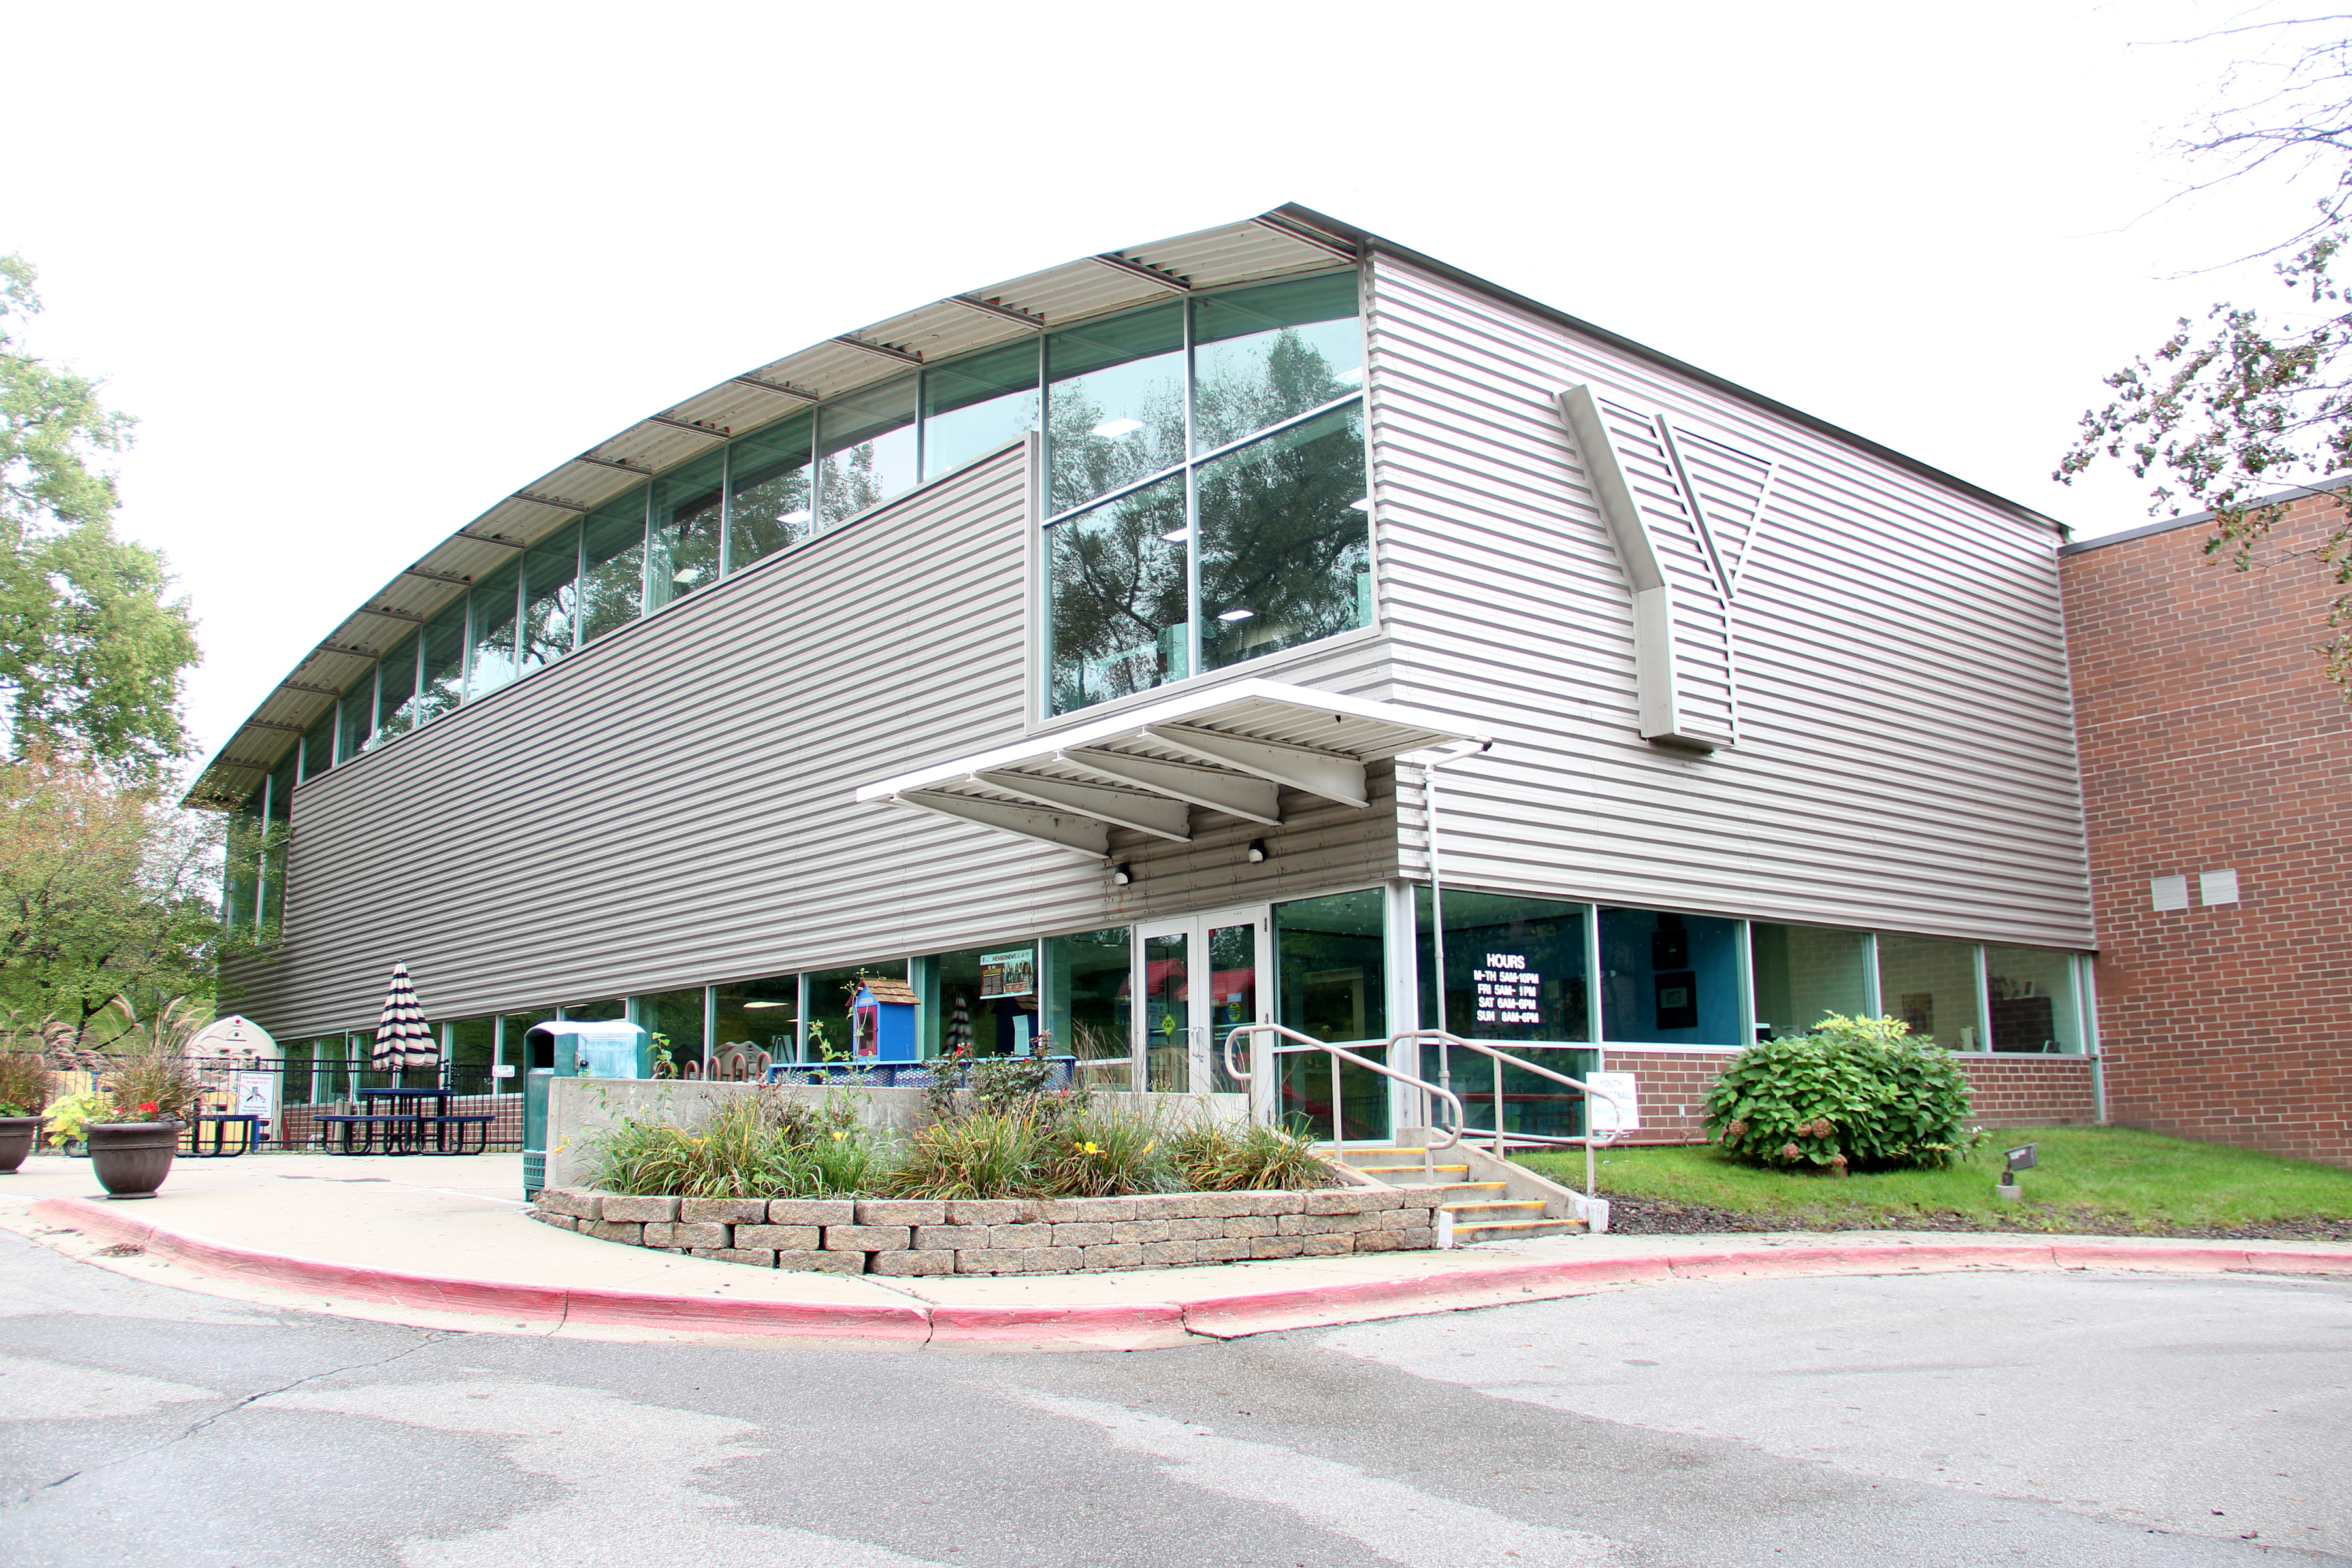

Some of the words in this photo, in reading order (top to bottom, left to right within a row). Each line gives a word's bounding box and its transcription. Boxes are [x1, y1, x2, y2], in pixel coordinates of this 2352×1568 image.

[1486, 953, 1526, 970] HOURS
[1473, 970, 1497, 982] M-TH
[1499, 972, 1539, 984] 5AM-10PM
[1477, 983, 1492, 995] FRI
[1494, 984, 1516, 996] 5AM-
[1478, 996, 1495, 1008] SAT
[1497, 997, 1537, 1010] 6AM-6PM
[1477, 1010, 1496, 1022] SUN
[1501, 1011, 1539, 1024] 8AM-6PM
